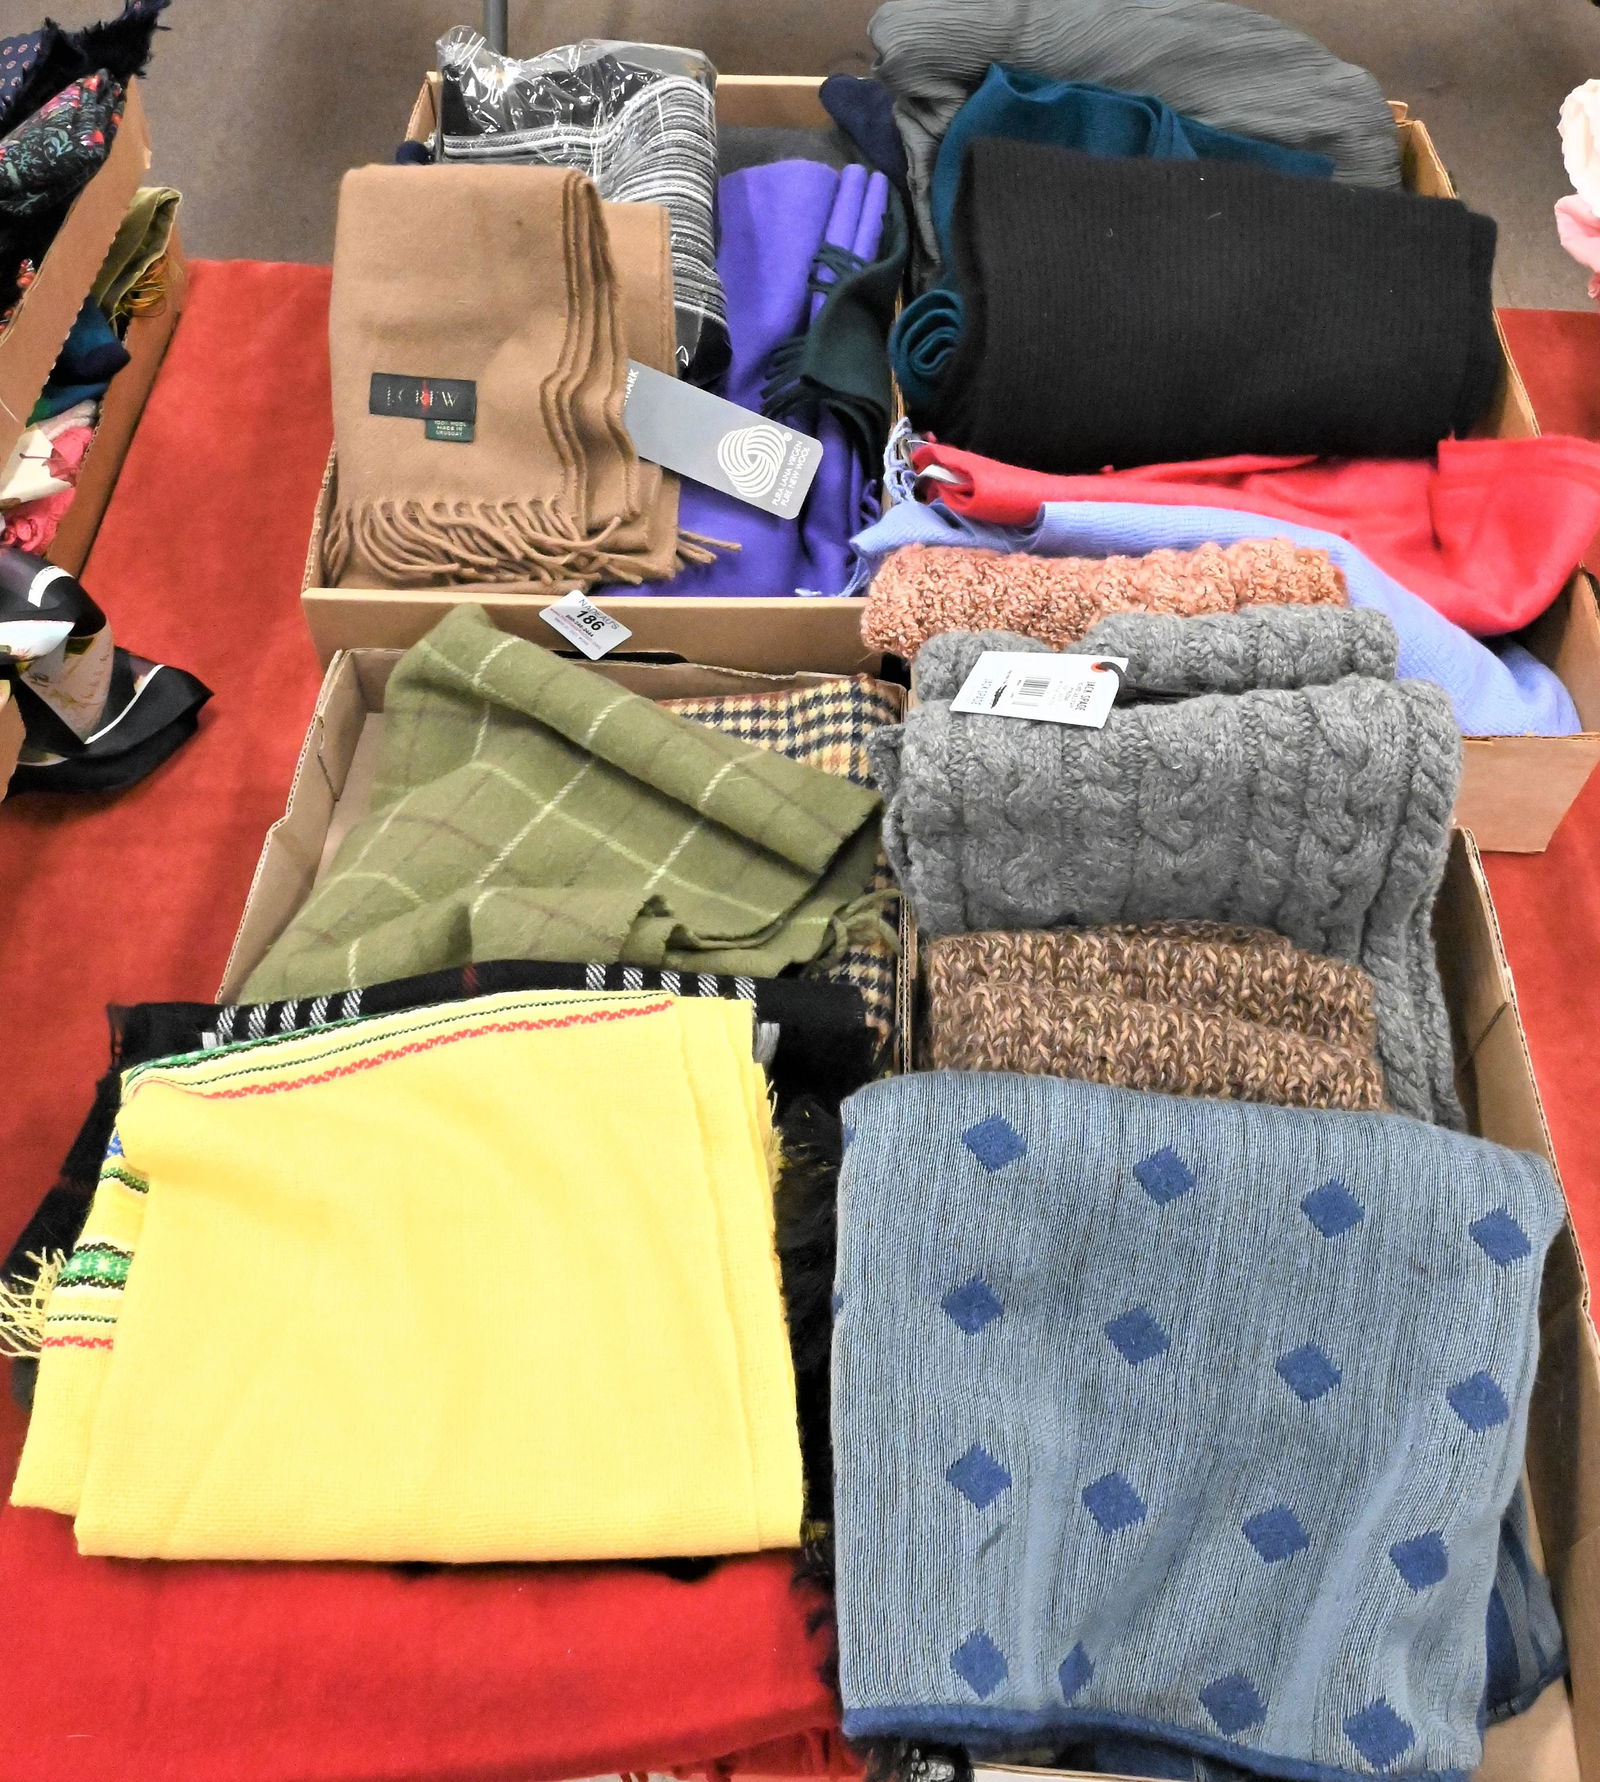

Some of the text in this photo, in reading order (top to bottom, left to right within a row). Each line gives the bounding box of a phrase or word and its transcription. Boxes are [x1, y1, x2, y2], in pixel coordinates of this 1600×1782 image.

[771, 440, 804, 506] PURA LANA VIRGEN
[780, 447, 811, 507] PURE NEW WOOL
[576, 610, 605, 631] 186
[579, 598, 620, 630] NADEAU'S
[1074, 694, 1091, 711] SPADE
